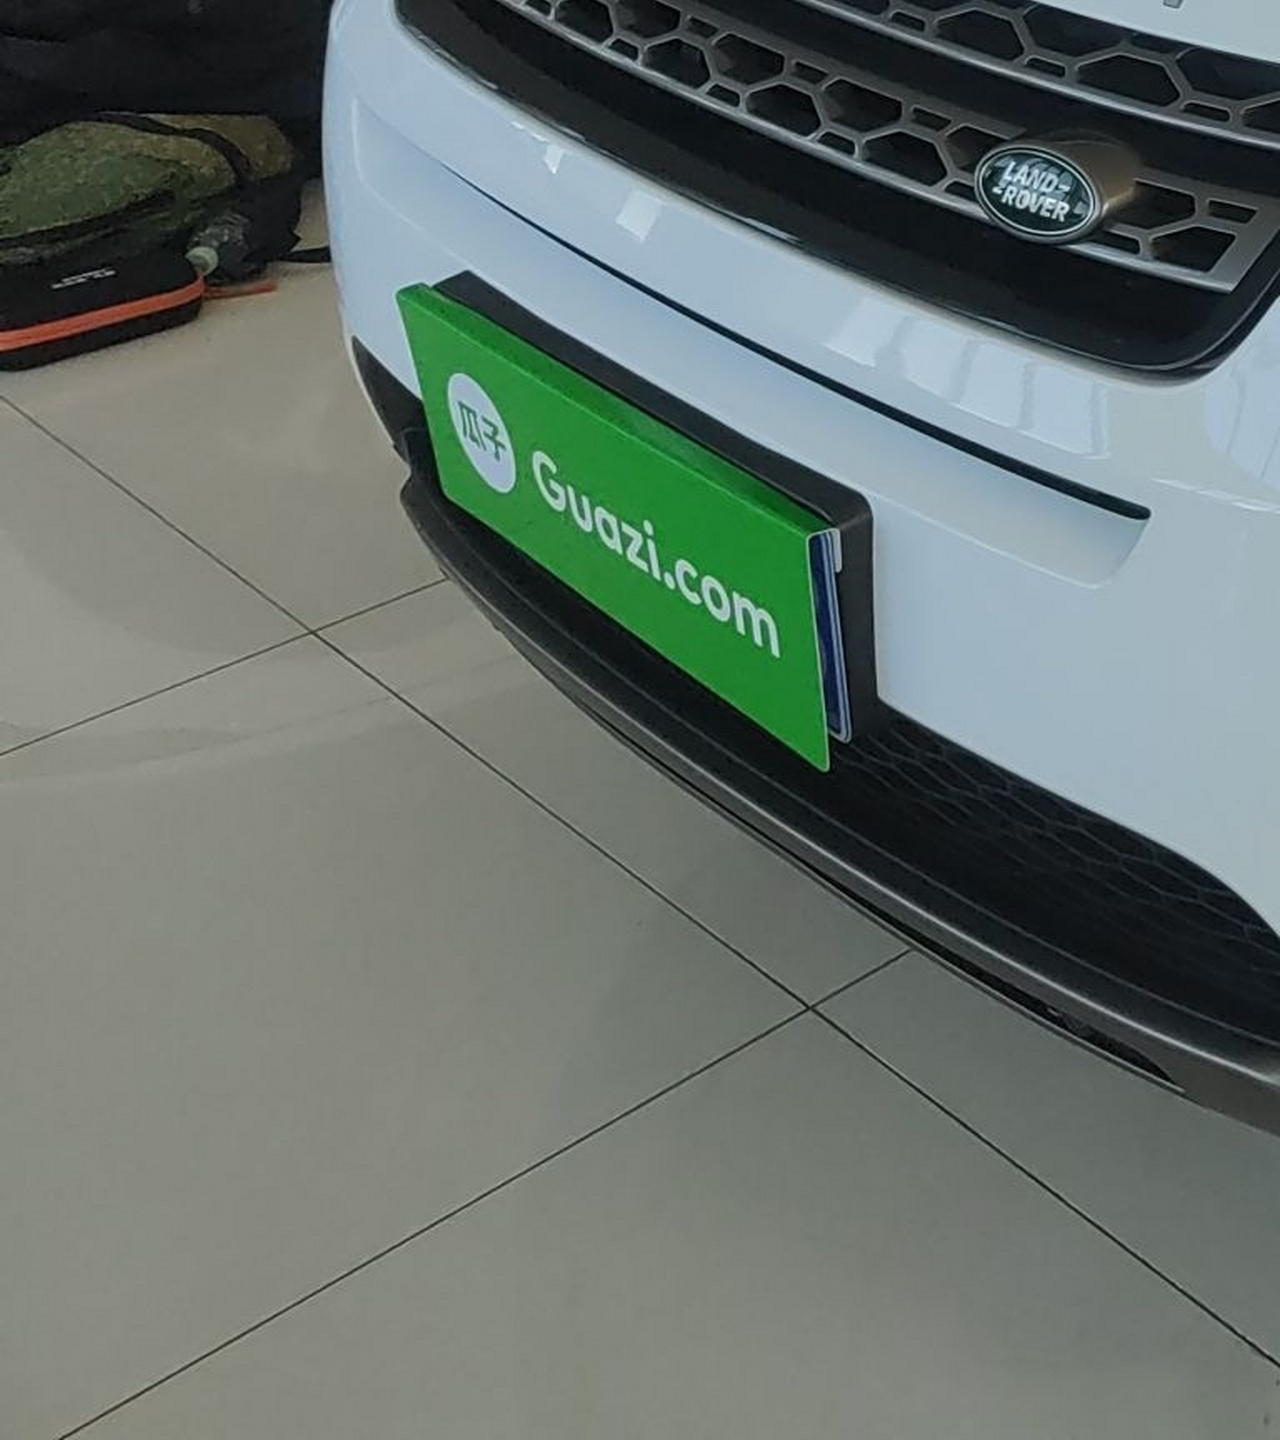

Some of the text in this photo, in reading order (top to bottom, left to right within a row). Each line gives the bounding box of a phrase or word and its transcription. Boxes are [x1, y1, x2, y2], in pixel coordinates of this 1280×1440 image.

[1001, 160, 1060, 194] LAND
[1001, 186, 1071, 222] ROVER
[457, 399, 508, 460] 瓜子
[531, 450, 781, 658] Guazi.com
